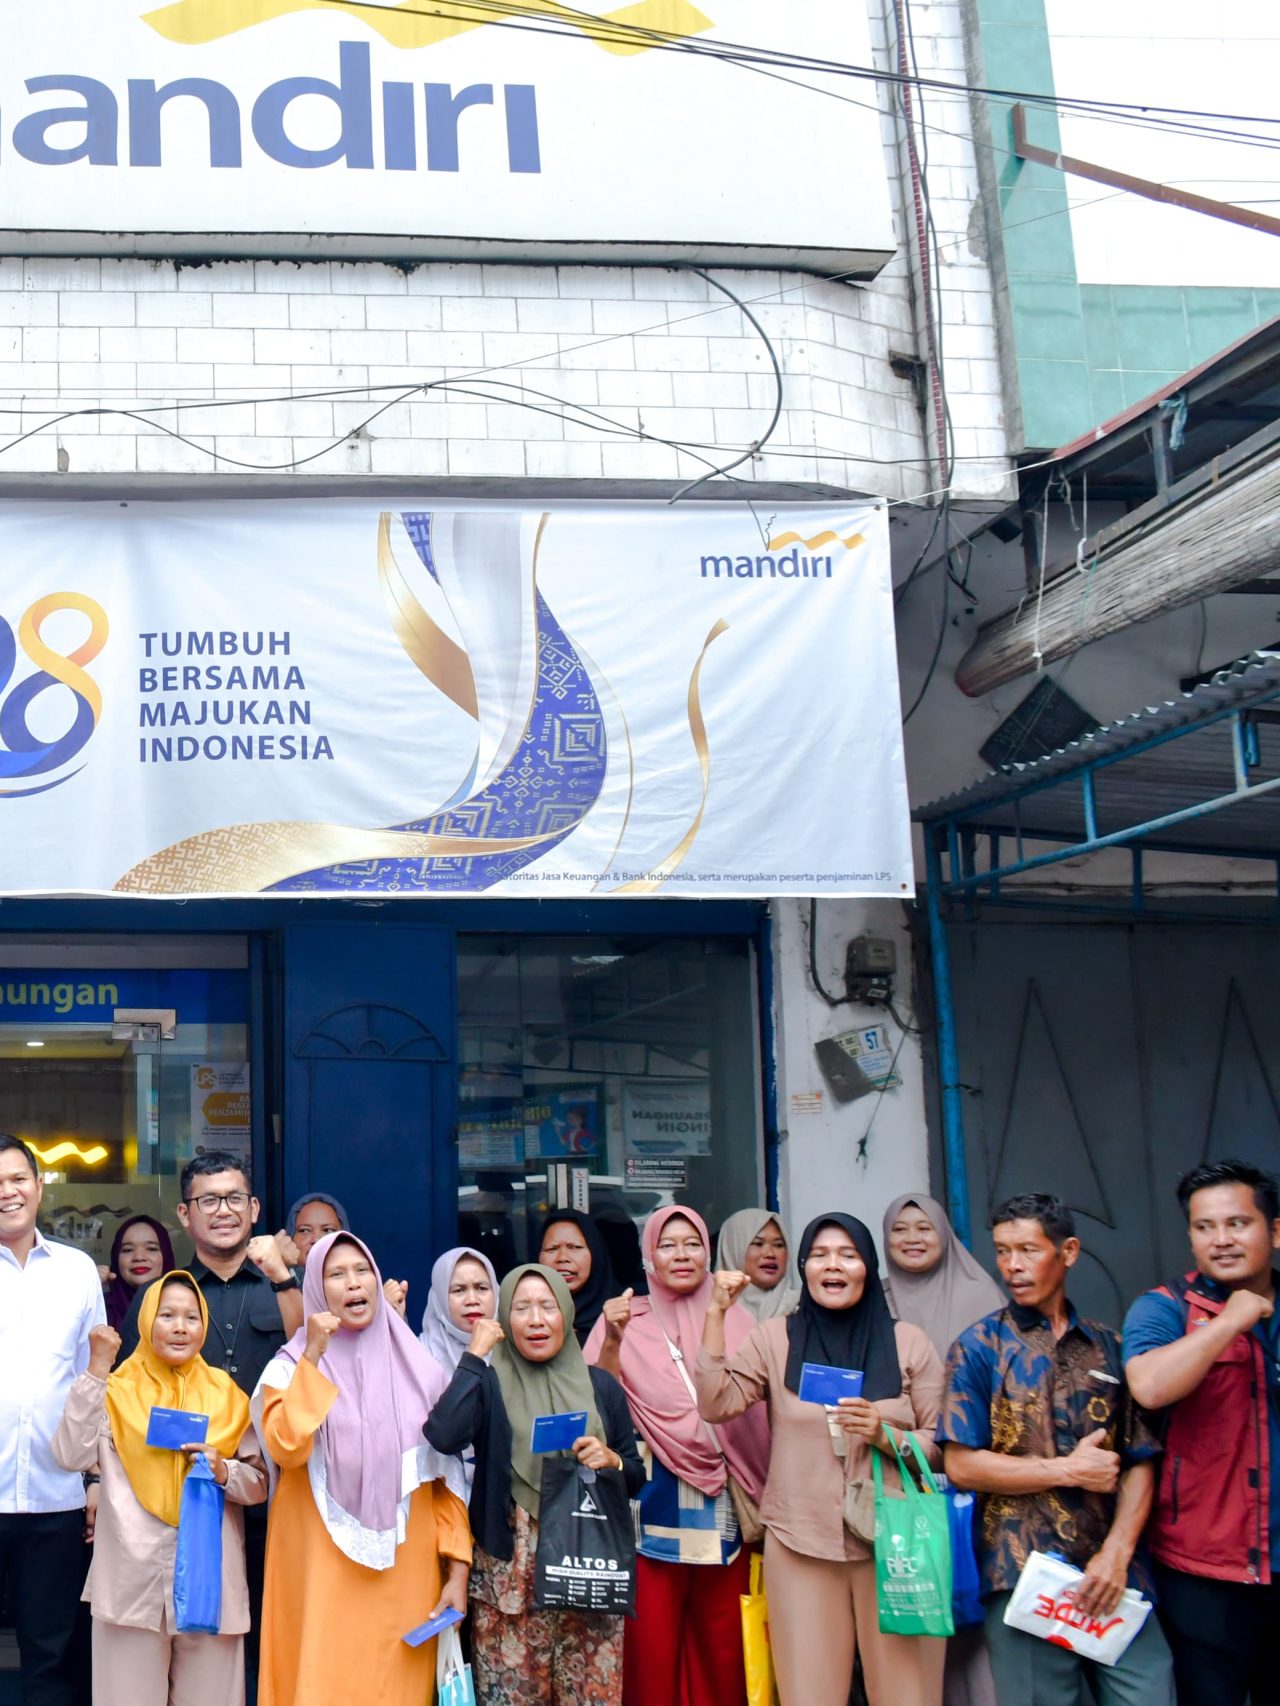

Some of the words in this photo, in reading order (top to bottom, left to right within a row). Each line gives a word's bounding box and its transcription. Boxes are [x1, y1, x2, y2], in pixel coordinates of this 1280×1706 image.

[700, 548, 833, 578] mandiri
[139, 631, 291, 657] TUMBUH
[139, 665, 306, 692] BERSAMA
[139, 700, 312, 727] MAJUKAN
[139, 735, 335, 763] INDONESIA
[542, 872, 561, 882] Jasa
[563, 872, 610, 884] Keuangan
[613, 872, 620, 881] &
[622, 871, 646, 881] Bank
[648, 871, 696, 883] Indonesia,
[698, 873, 721, 882] serta
[723, 872, 777, 883] merupakan
[779, 872, 814, 883] peserta
[816, 872, 874, 884] penjaminan
[875, 871, 892, 881] LPS
[561, 1555, 619, 1571] ALTOS
[568, 1570, 594, 1578] QUALITY
